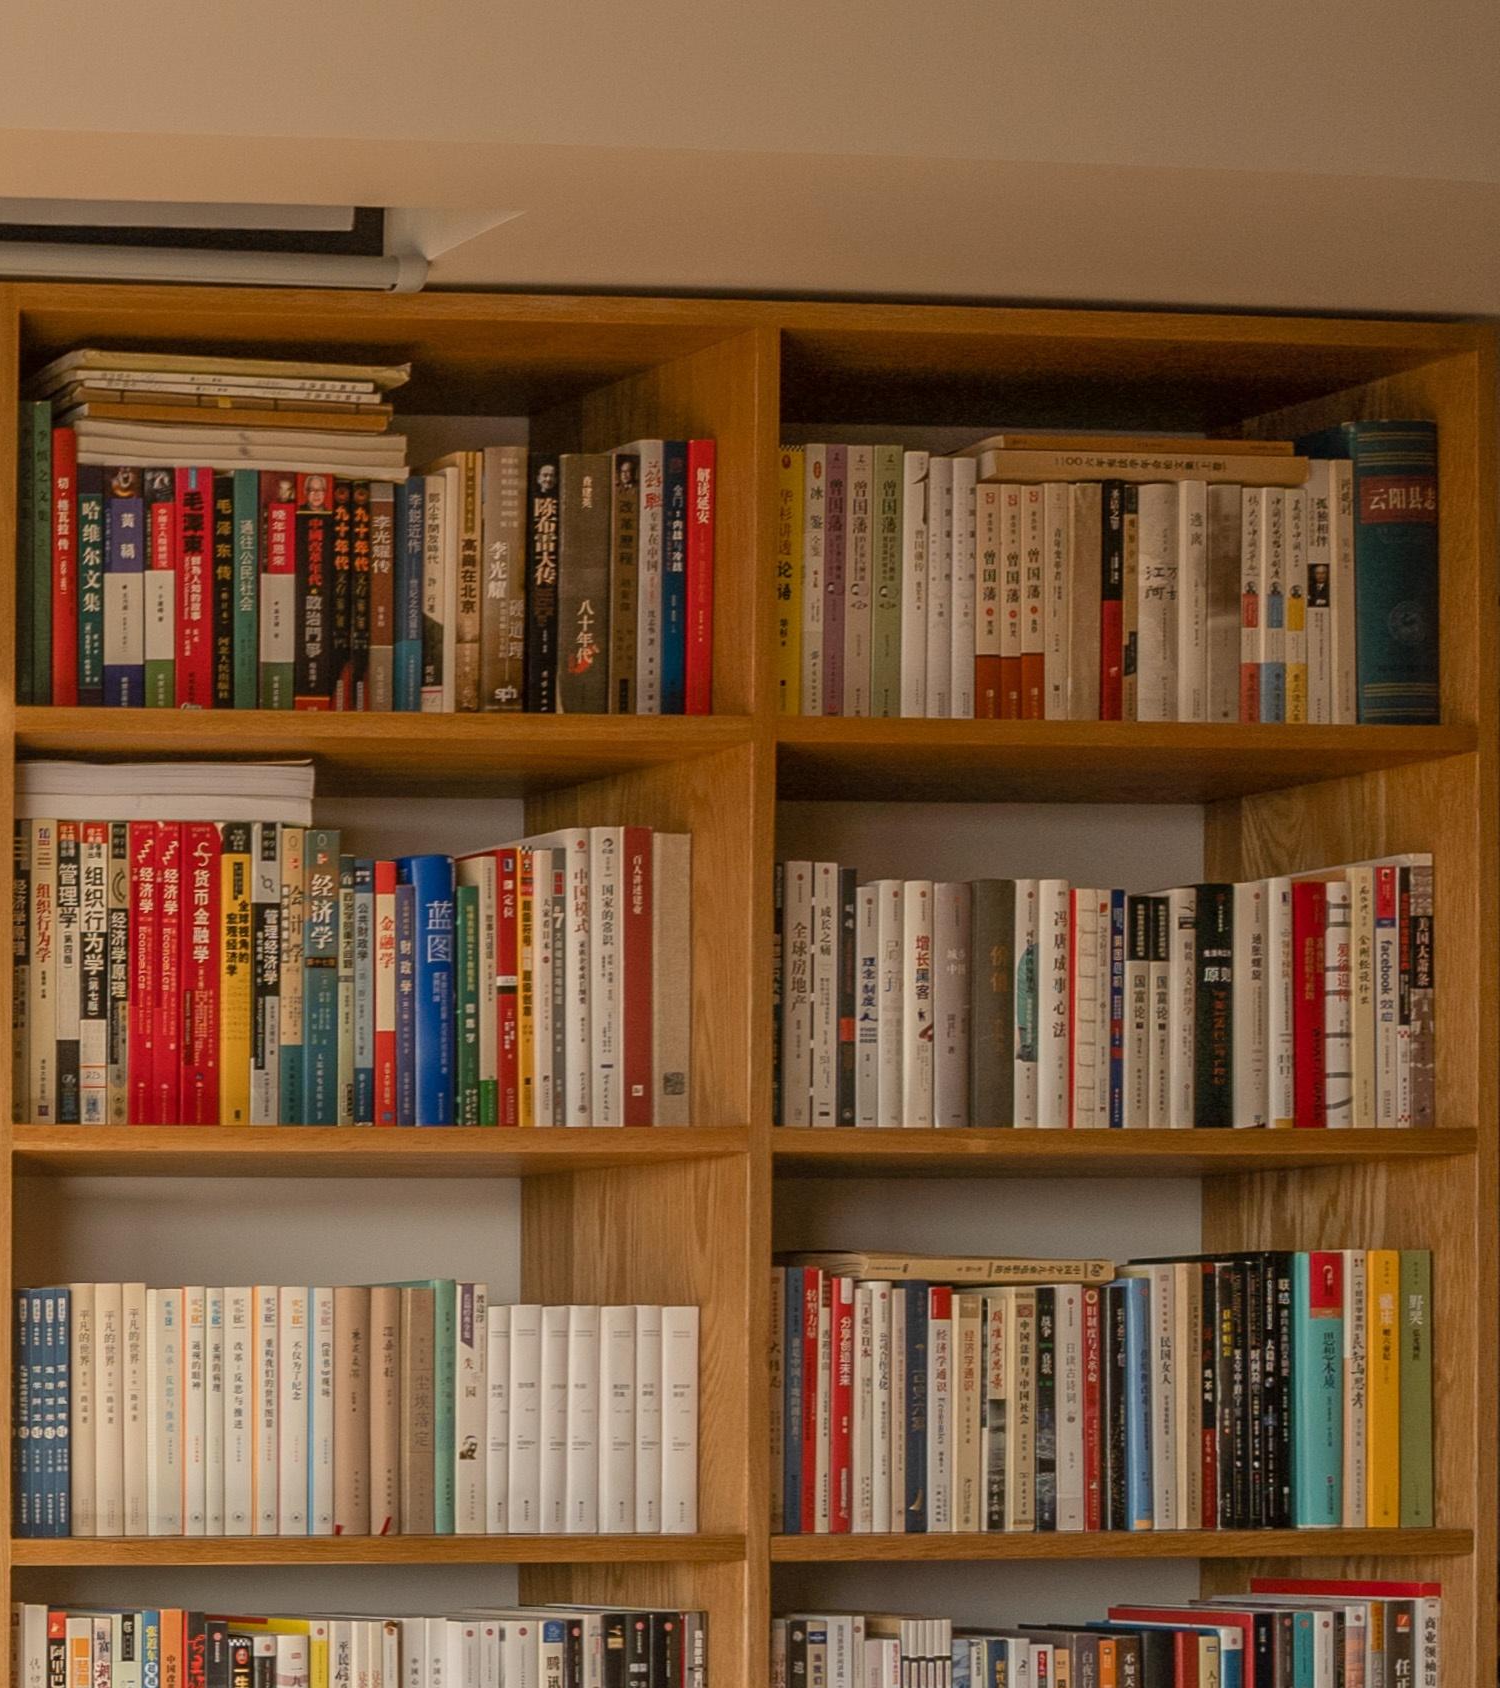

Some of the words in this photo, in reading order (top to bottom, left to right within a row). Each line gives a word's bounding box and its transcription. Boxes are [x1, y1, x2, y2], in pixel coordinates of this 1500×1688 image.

[577, 601, 594, 665] 八十年代
[59, 864, 80, 926] 管理学
[83, 866, 103, 976] 组织行为学
[193, 870, 211, 963] 货币金融学
[309, 872, 333, 950] 经济学
[110, 913, 127, 998] 经济学原理
[425, 899, 453, 964] 蓝图
[916, 935, 931, 1000] 增长黑客
[1382, 940, 1393, 994] facebook
